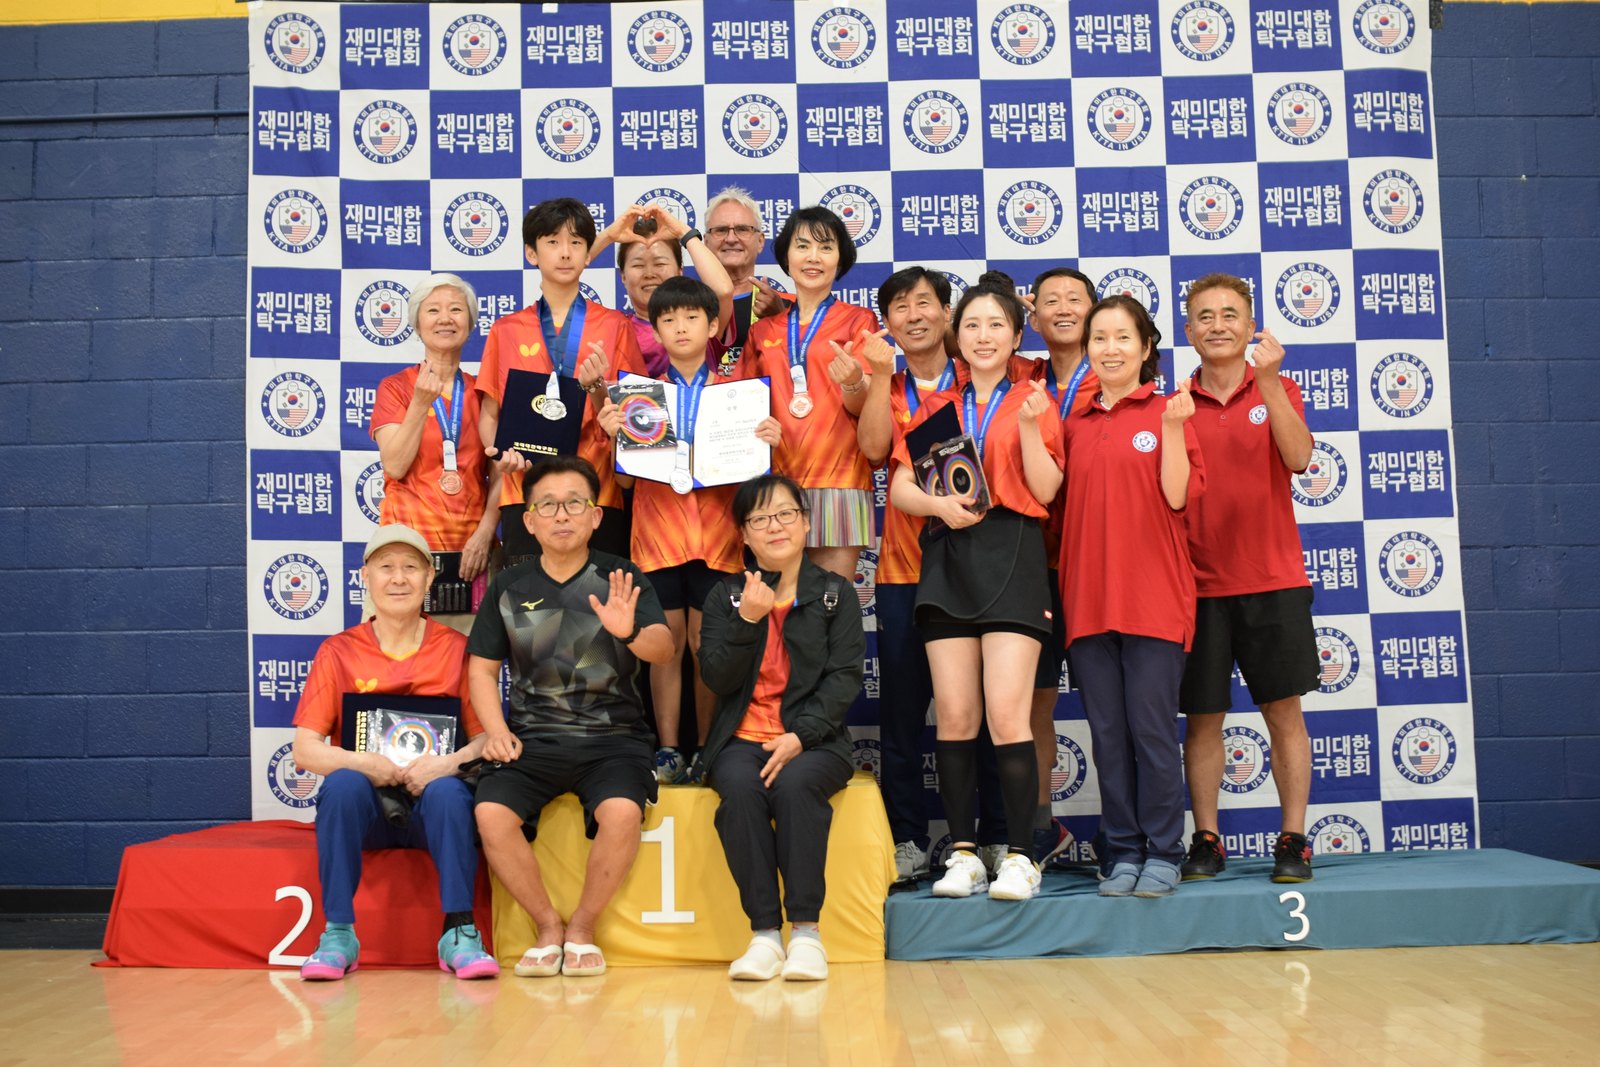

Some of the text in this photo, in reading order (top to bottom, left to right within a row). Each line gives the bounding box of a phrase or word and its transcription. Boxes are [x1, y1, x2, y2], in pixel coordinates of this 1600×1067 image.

[895, 17, 972, 36] 재미대한
[1075, 14, 1151, 33] 재미대한
[1255, 10, 1331, 29] 재미대한
[345, 28, 421, 46] 재미대한
[526, 25, 603, 44] 재미대한
[712, 21, 789, 40] 재미대한
[1257, 28, 1332, 48] 탁구협회
[713, 40, 788, 59] 탁구협회
[896, 36, 972, 56] 탁구협회
[1076, 33, 1151, 53] 탁구협회
[346, 47, 420, 66] 탁구협회
[527, 44, 602, 64] 탁구협회
[633, 52, 653, 70] KTTA
[671, 52, 688, 67] USA
[817, 49, 837, 66] KTTA
[855, 49, 872, 64] USA
[996, 45, 1017, 63] KTTA
[1035, 46, 1051, 61] USA
[448, 56, 468, 74] KTTA
[486, 56, 502, 71] USA
[1171, 98, 1247, 118] 재미대한
[1353, 91, 1424, 112] 재미대한
[258, 110, 331, 131] 재미대한
[620, 109, 698, 130] 재미대한
[806, 106, 883, 126] 재미대한
[989, 102, 1066, 122] 재미대한
[437, 113, 514, 133] 재미대한
[990, 122, 1066, 142] 탁구협회
[1172, 117, 1247, 138] 탁구협회
[1354, 112, 1425, 133] 탁구협회
[259, 130, 330, 152] 탁구협회
[438, 133, 513, 153] 탁구협회
[621, 129, 697, 150] 탁구협회
[807, 125, 882, 146] 탁구협회
[909, 134, 930, 152] KTTA
[948, 134, 964, 149] USA
[1093, 130, 1113, 148] KTTA
[1132, 131, 1148, 146] USA
[1273, 125, 1293, 143] KTTA
[1312, 125, 1328, 141] USA
[359, 143, 378, 162] KTTA
[396, 144, 413, 160] USA
[541, 142, 561, 160] KTTA
[580, 142, 596, 158] USA
[728, 137, 748, 156] KTTA
[767, 138, 783, 154] USA
[901, 195, 979, 215] 재미대한
[1082, 192, 1159, 212] 재미대한
[1264, 185, 1341, 206] 재미대한
[345, 204, 422, 225] 재미대한
[1084, 211, 1159, 232] 탁구협회
[1265, 205, 1341, 227] 탁구협회
[346, 224, 421, 246] 탁구협회
[902, 214, 978, 236] 탁구협회
[1003, 224, 1024, 243] KTTA
[1042, 224, 1059, 240] USA
[1185, 220, 1205, 238] KTTA
[1223, 220, 1239, 235] USA
[269, 232, 288, 251] KTTA
[306, 234, 323, 250] USA
[449, 235, 469, 254] KTTA
[488, 236, 504, 252] USA
[1362, 273, 1435, 293] 재미대한
[256, 292, 332, 312] 재미대한
[1363, 293, 1435, 314] 탁구협회
[256, 312, 331, 334] 탁구협회
[1281, 306, 1302, 325] KTTA
[1320, 306, 1336, 322] USA
[360, 325, 380, 344] KTTA
[1376, 397, 1396, 416] KTTA
[1414, 398, 1429, 414] USA
[266, 415, 286, 434] KTTA
[304, 417, 321, 433] USA
[1368, 450, 1444, 472] 재미대한
[256, 472, 333, 492] 재미대한
[1370, 471, 1444, 492] 탁구협회
[1328, 485, 1344, 501] USA
[257, 493, 332, 514] 탁구협회
[1302, 548, 1358, 570] 미대한
[1385, 576, 1406, 595] KTTA
[1424, 576, 1440, 592] USA
[269, 598, 289, 617] KTTA
[308, 600, 324, 616] USA
[1380, 636, 1456, 658] 재미대한
[1382, 656, 1457, 679] 탁구협회
[1308, 734, 1370, 757] 미대한
[1311, 755, 1370, 778] 구협회
[1398, 763, 1418, 782] KTTA
[1436, 763, 1453, 779] USA
[1066, 780, 1082, 796] USA
[1392, 822, 1468, 845] 재미대한
[641, 816, 695, 924] 1
[268, 885, 314, 966] 2
[1279, 891, 1311, 942] 3
